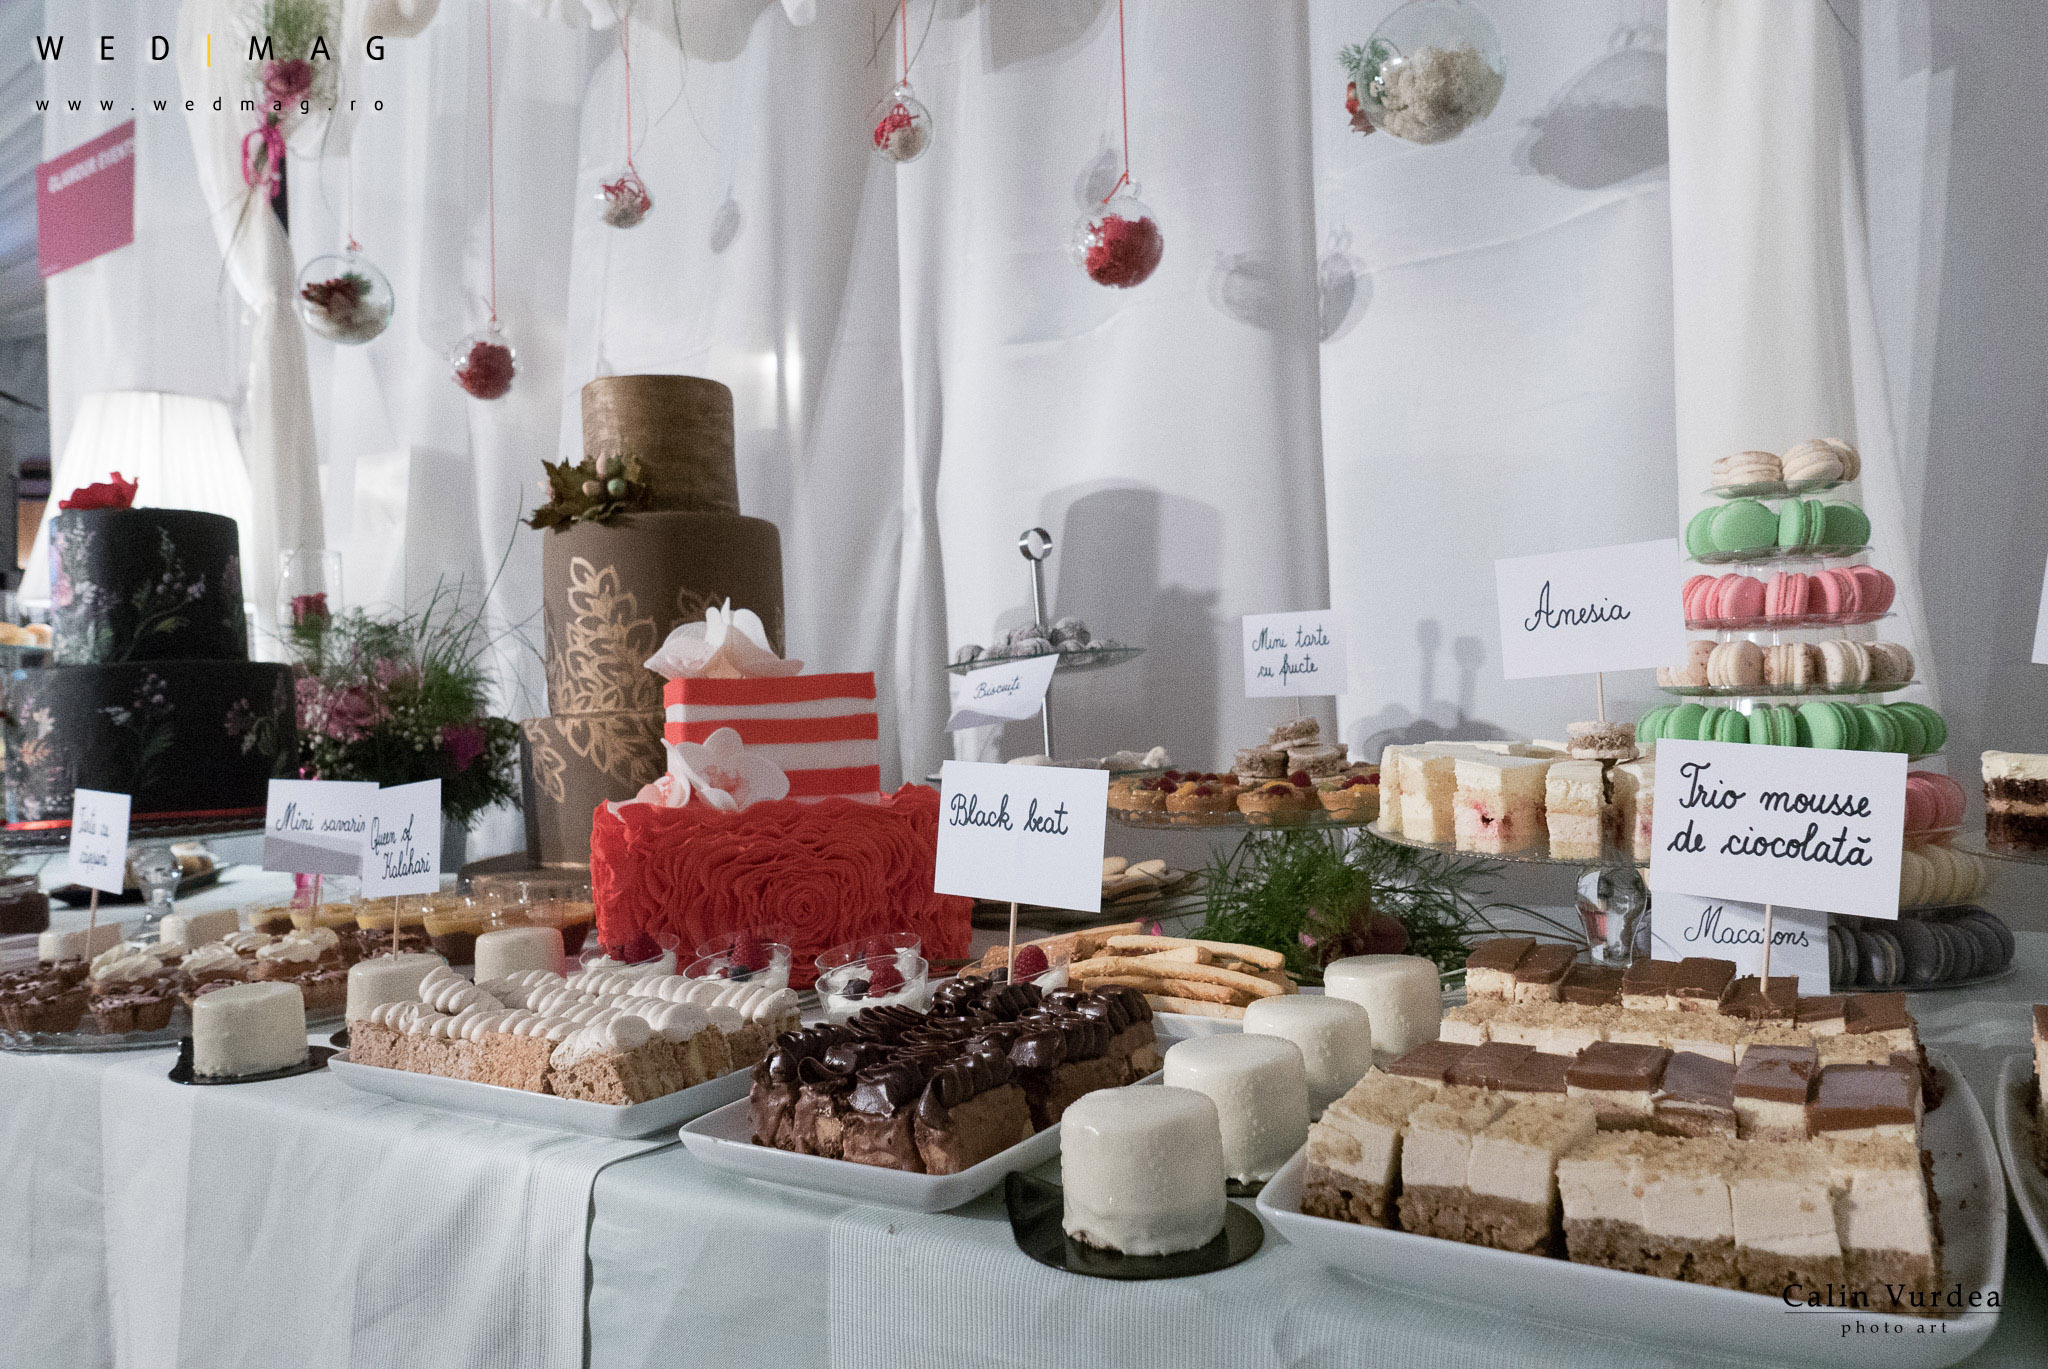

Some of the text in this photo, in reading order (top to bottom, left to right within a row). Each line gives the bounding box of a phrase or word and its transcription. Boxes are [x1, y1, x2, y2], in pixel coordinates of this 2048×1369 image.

[1524, 580, 1631, 632] Anesia
[1252, 624, 1330, 652] Mini tarte
[1257, 653, 1318, 687] cu fructe
[1678, 761, 1872, 818] Trio mousse
[275, 802, 314, 832] Mini
[949, 792, 1014, 831] Black
[370, 813, 415, 856] Queen of
[1666, 819, 1873, 867] de ciocolată
[381, 847, 431, 880] Kalahari
